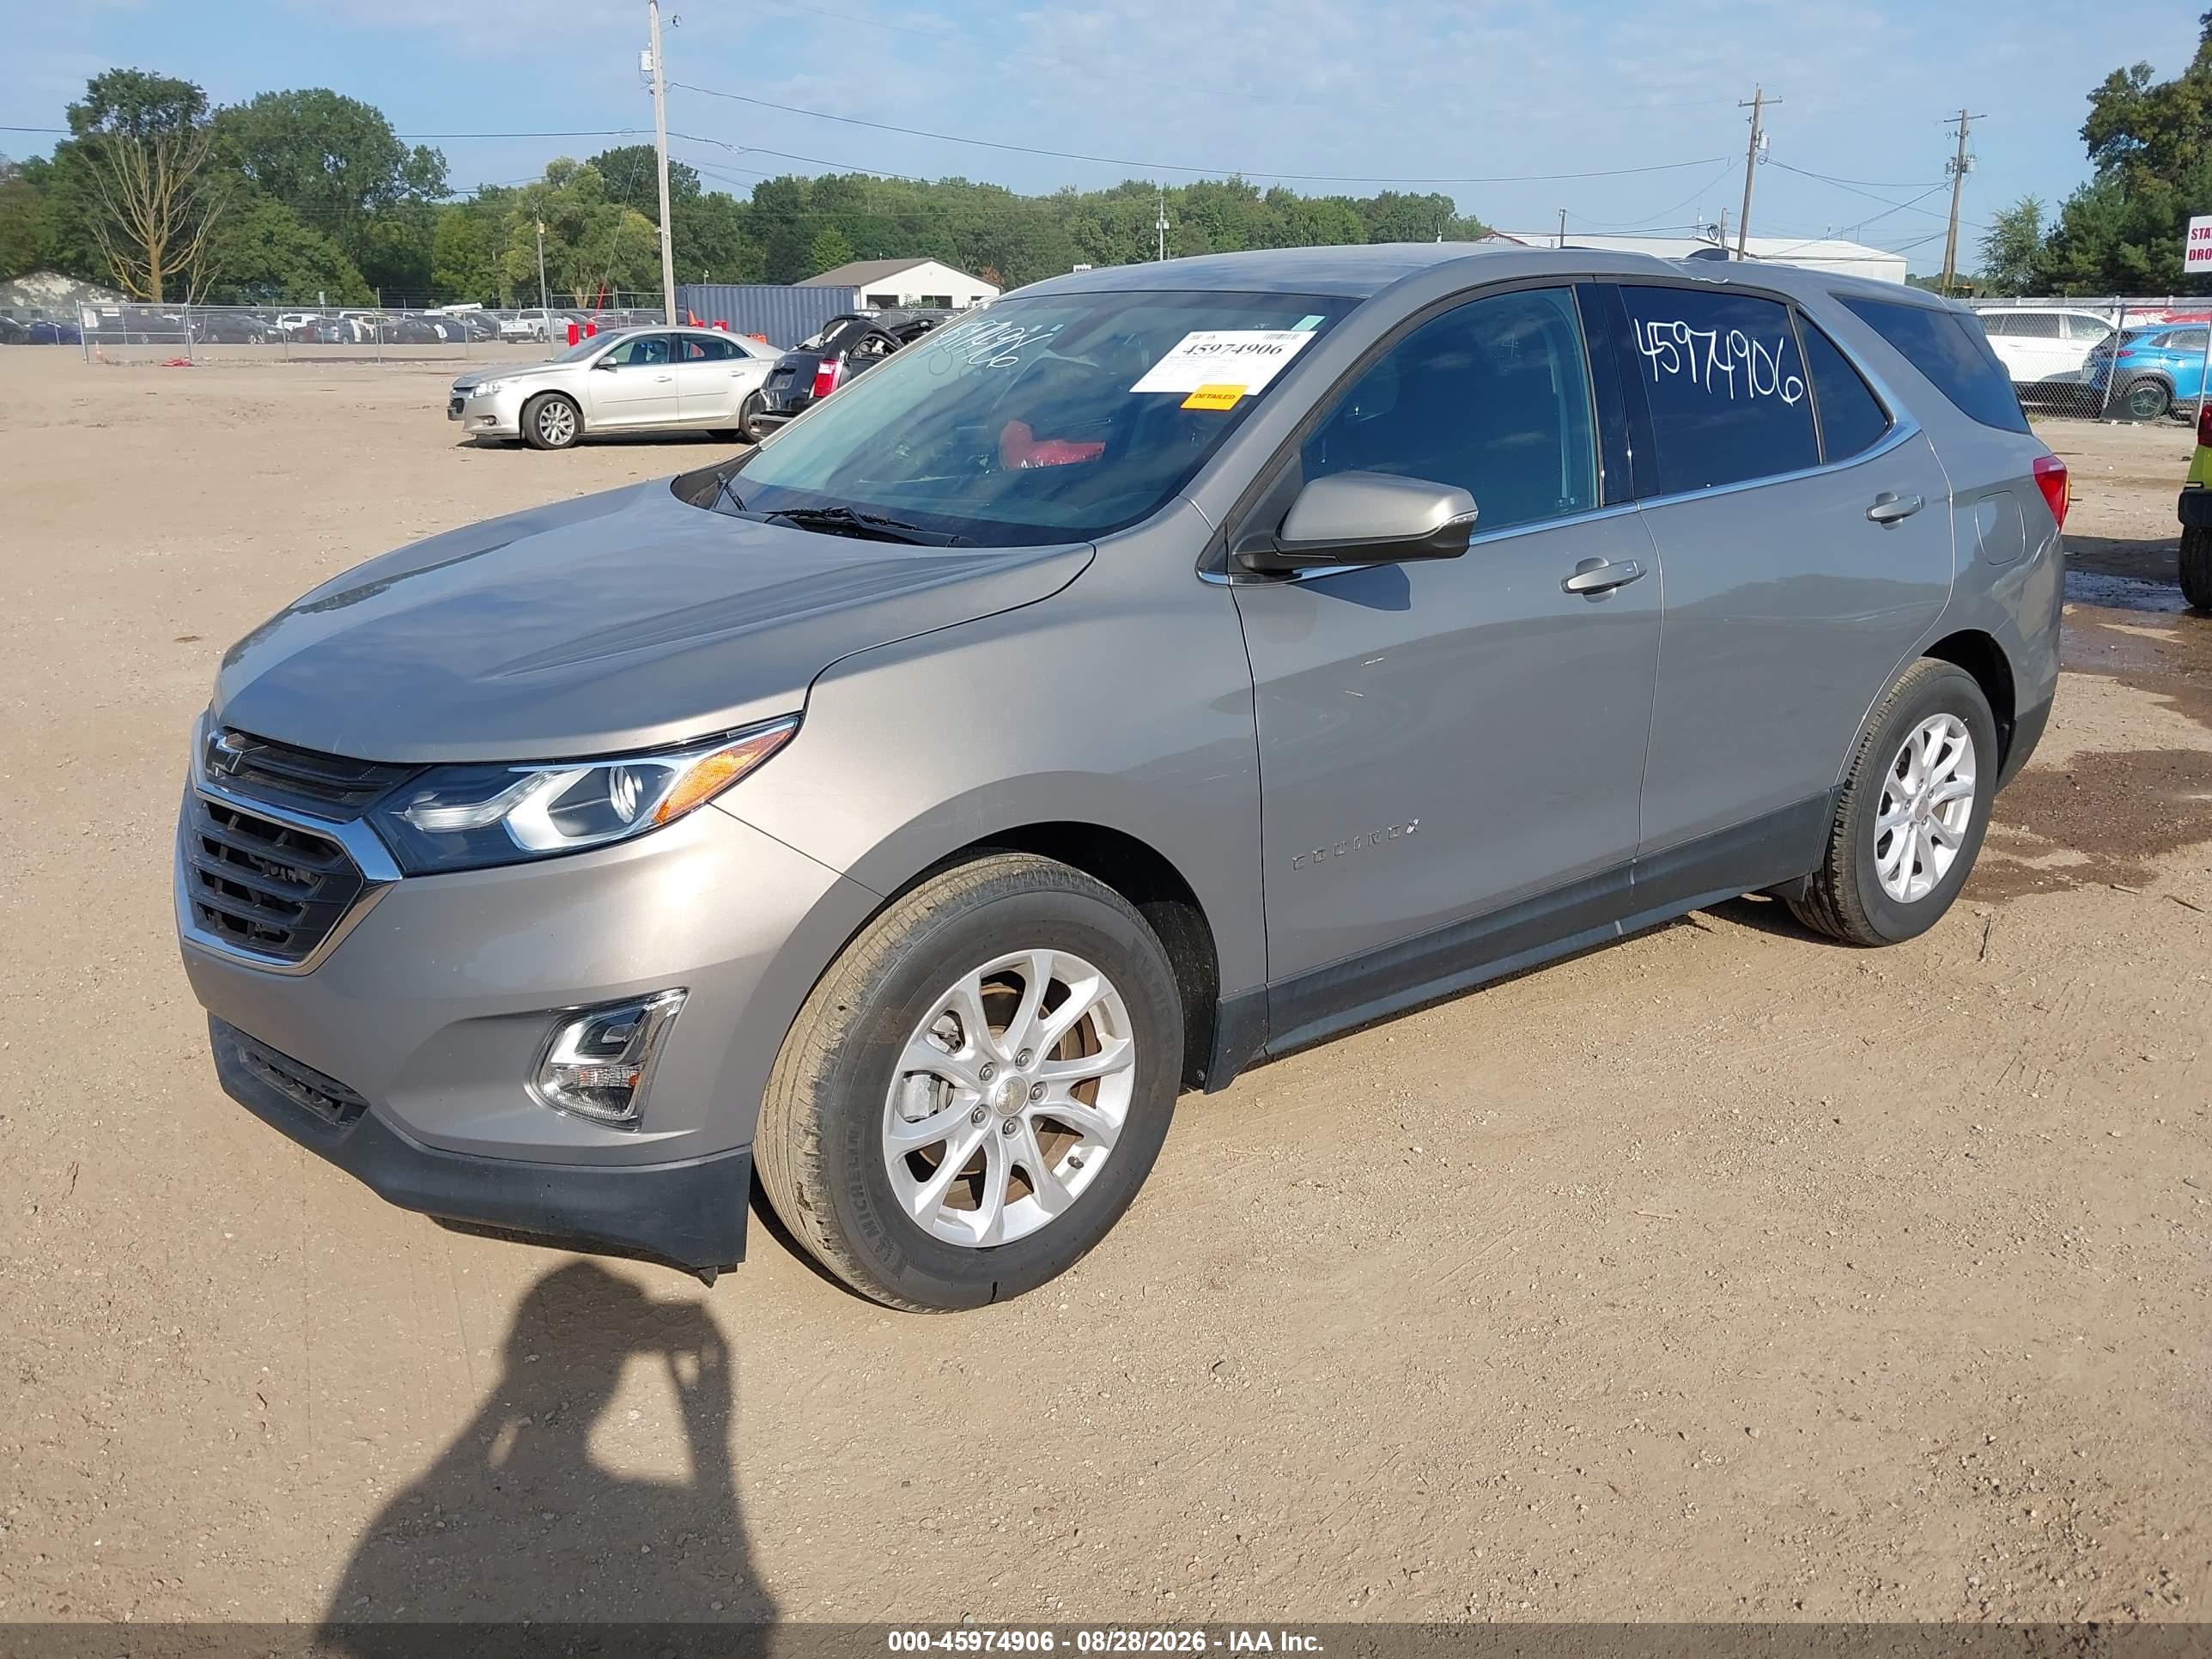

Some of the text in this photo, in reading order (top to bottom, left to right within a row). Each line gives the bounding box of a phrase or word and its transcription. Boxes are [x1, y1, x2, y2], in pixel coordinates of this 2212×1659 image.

[2191, 228, 2212, 240] STA
[1182, 343, 1286, 356] 45974906
[1634, 318, 1804, 407] 45974906
[1291, 817, 1421, 872] EQUINOX
[845, 1127, 881, 1238] MICHELIN
